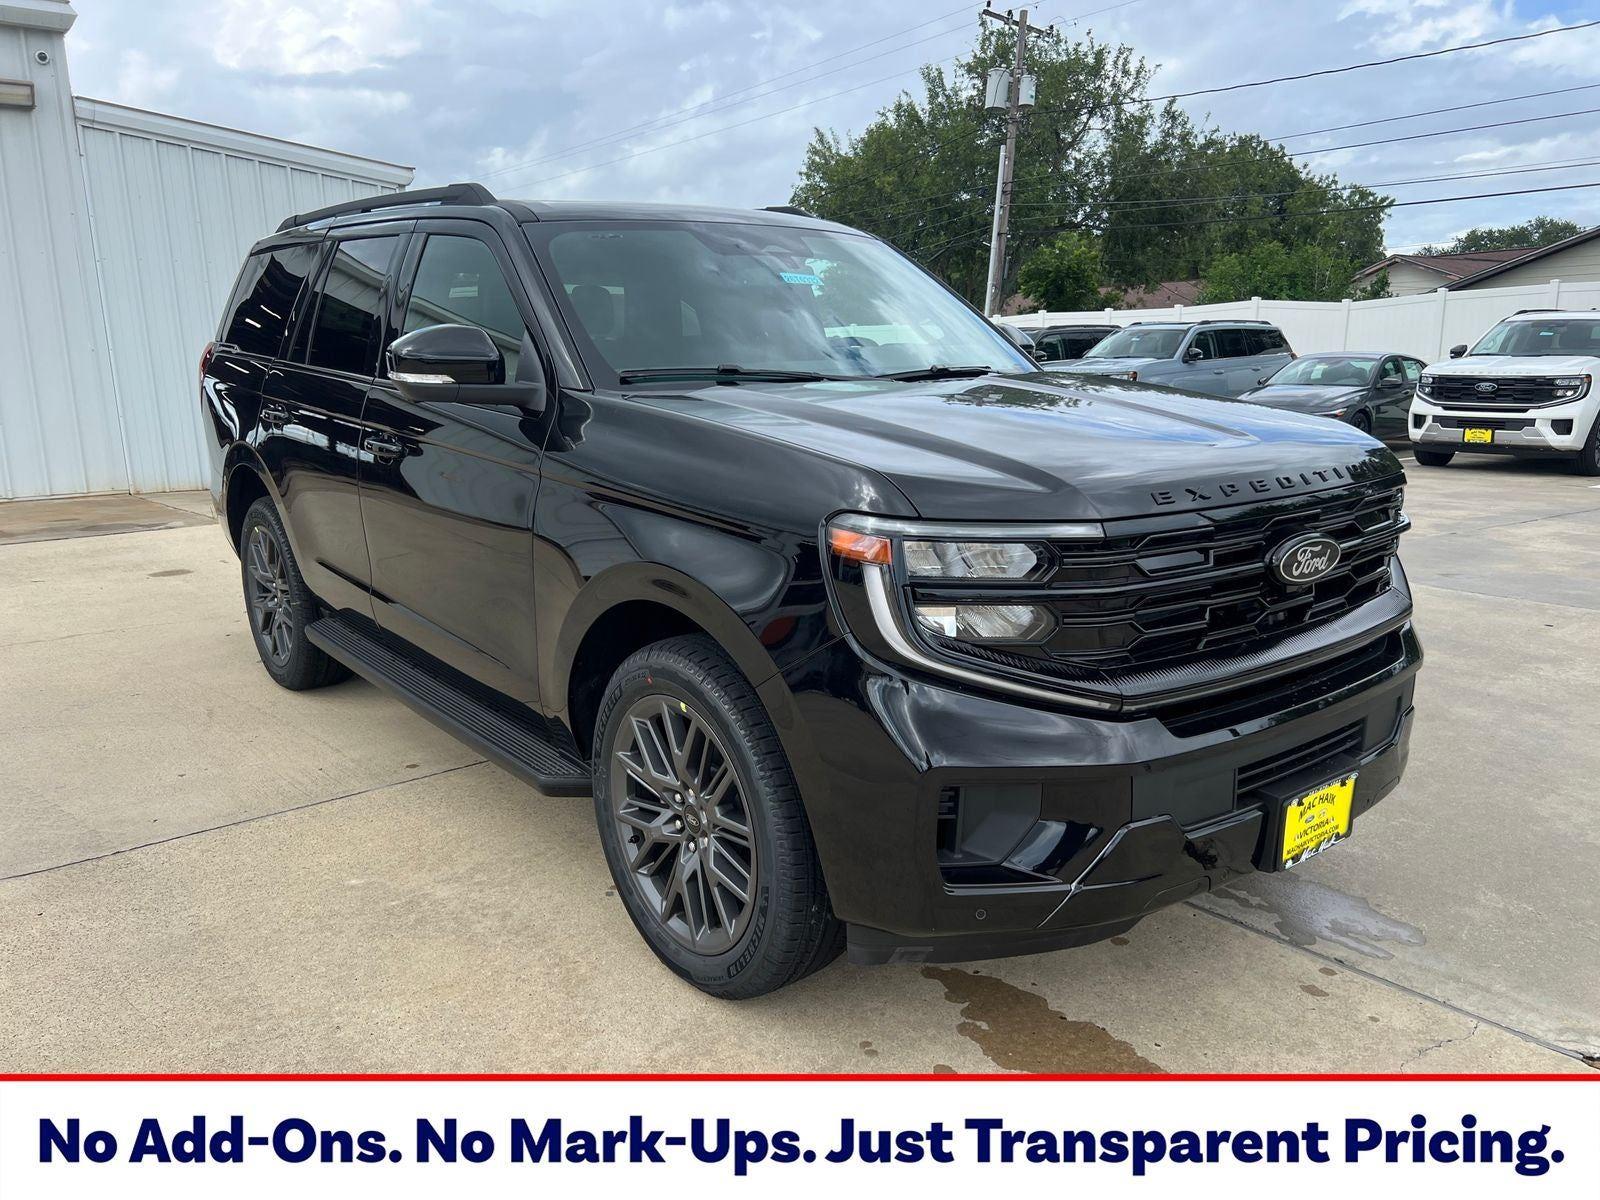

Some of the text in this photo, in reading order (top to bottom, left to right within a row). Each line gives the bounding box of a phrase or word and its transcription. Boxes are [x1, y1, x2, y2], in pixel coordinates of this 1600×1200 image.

[1151, 457, 1379, 506] EXPEDITION
[1292, 544, 1331, 575] Ford
[1298, 796, 1318, 822] MAC
[1317, 792, 1337, 806] HAIK
[729, 912, 767, 978] MICHELIN
